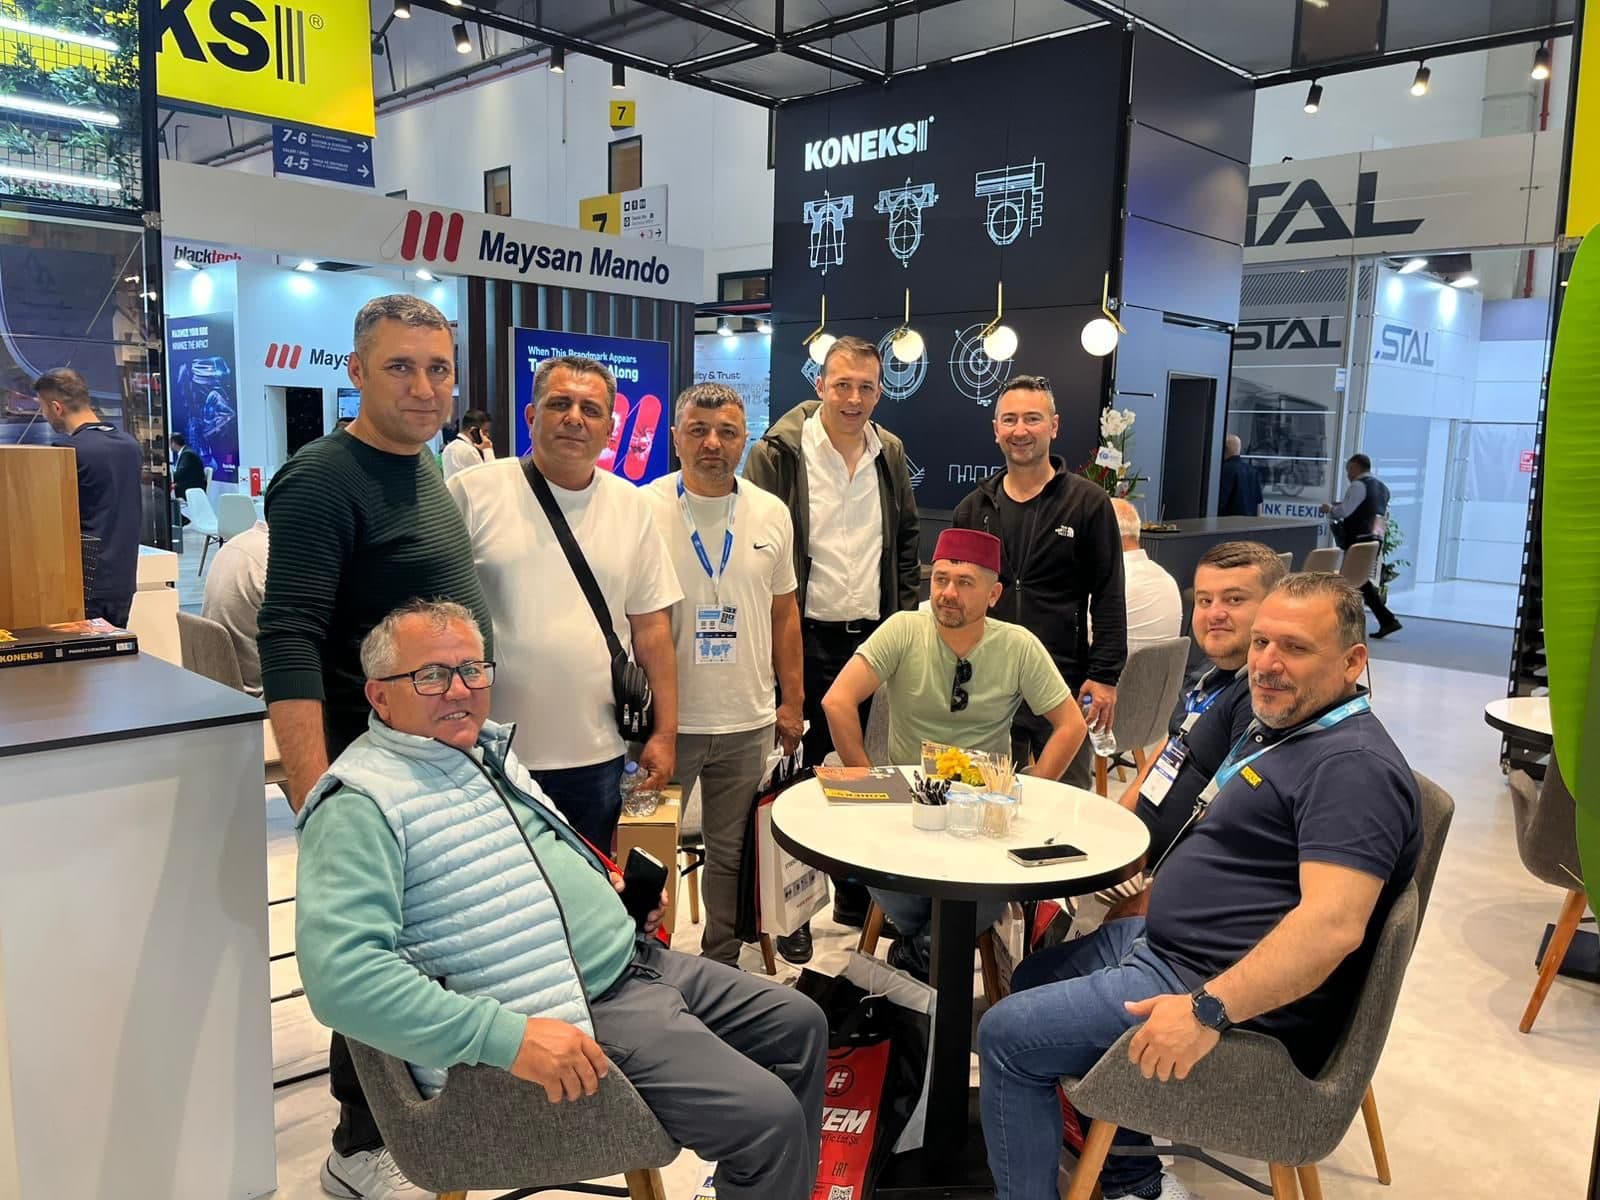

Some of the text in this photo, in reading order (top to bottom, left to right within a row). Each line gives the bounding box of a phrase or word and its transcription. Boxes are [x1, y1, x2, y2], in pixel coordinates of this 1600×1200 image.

[617, 106, 626, 121] 7
[282, 129, 307, 145] 7-6
[804, 120, 928, 172] KONEKSI
[283, 155, 310, 170] 4-5
[592, 212, 608, 232] 7
[479, 230, 670, 285] Maysan Mando
[528, 345, 549, 356] When
[551, 347, 566, 358] This
[609, 352, 637, 364] Appears
[717, 370, 742, 380] Trust
